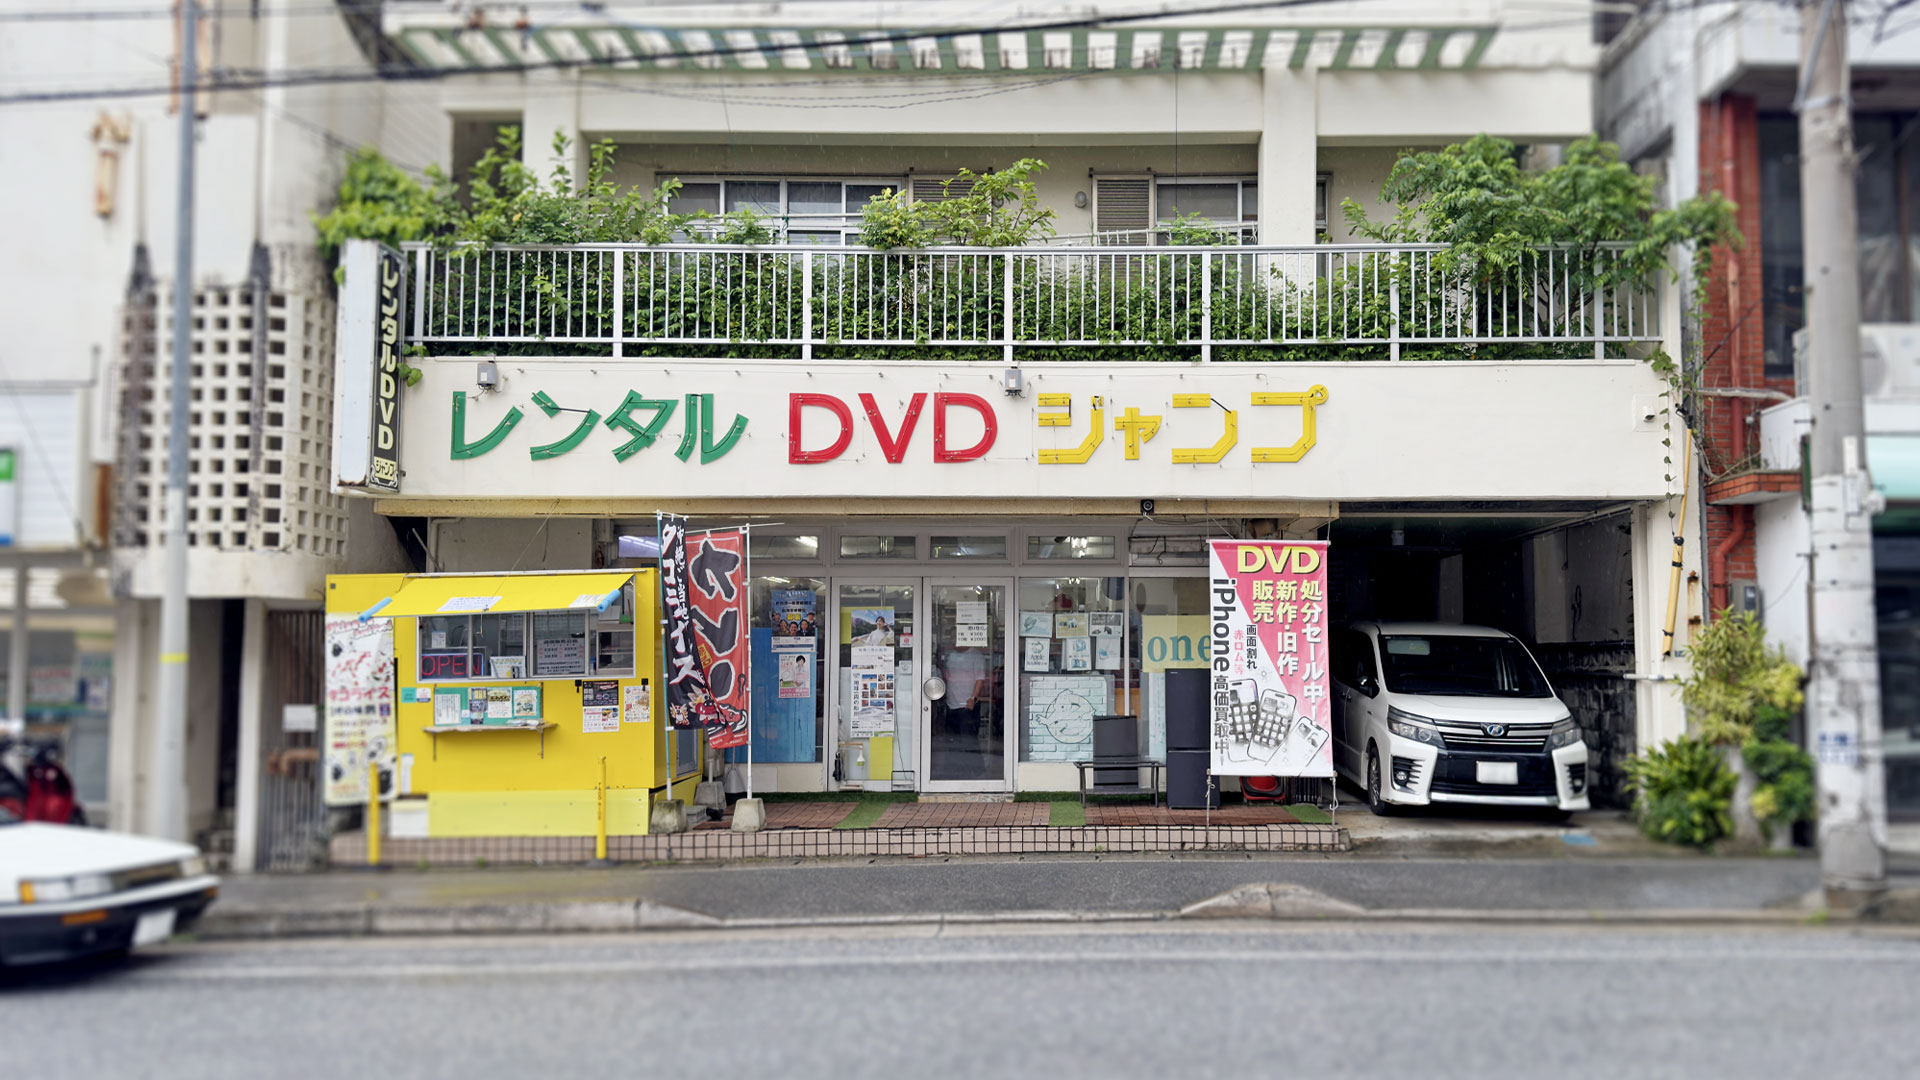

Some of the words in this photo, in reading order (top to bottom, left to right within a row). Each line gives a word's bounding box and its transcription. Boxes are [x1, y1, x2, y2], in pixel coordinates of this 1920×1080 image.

[378, 254, 399, 451] レンタルDVD
[450, 388, 749, 466] レンタル
[788, 392, 998, 465] DVD
[1038, 384, 1329, 465] ジャンプ
[1237, 545, 1321, 574] DVD
[1212, 578, 1237, 672] iPhone
[1252, 579, 1274, 624] 販売
[1276, 579, 1299, 677] 新作・旧作
[421, 655, 480, 676] OPEN
[1246, 624, 1258, 671] 画面割れ
